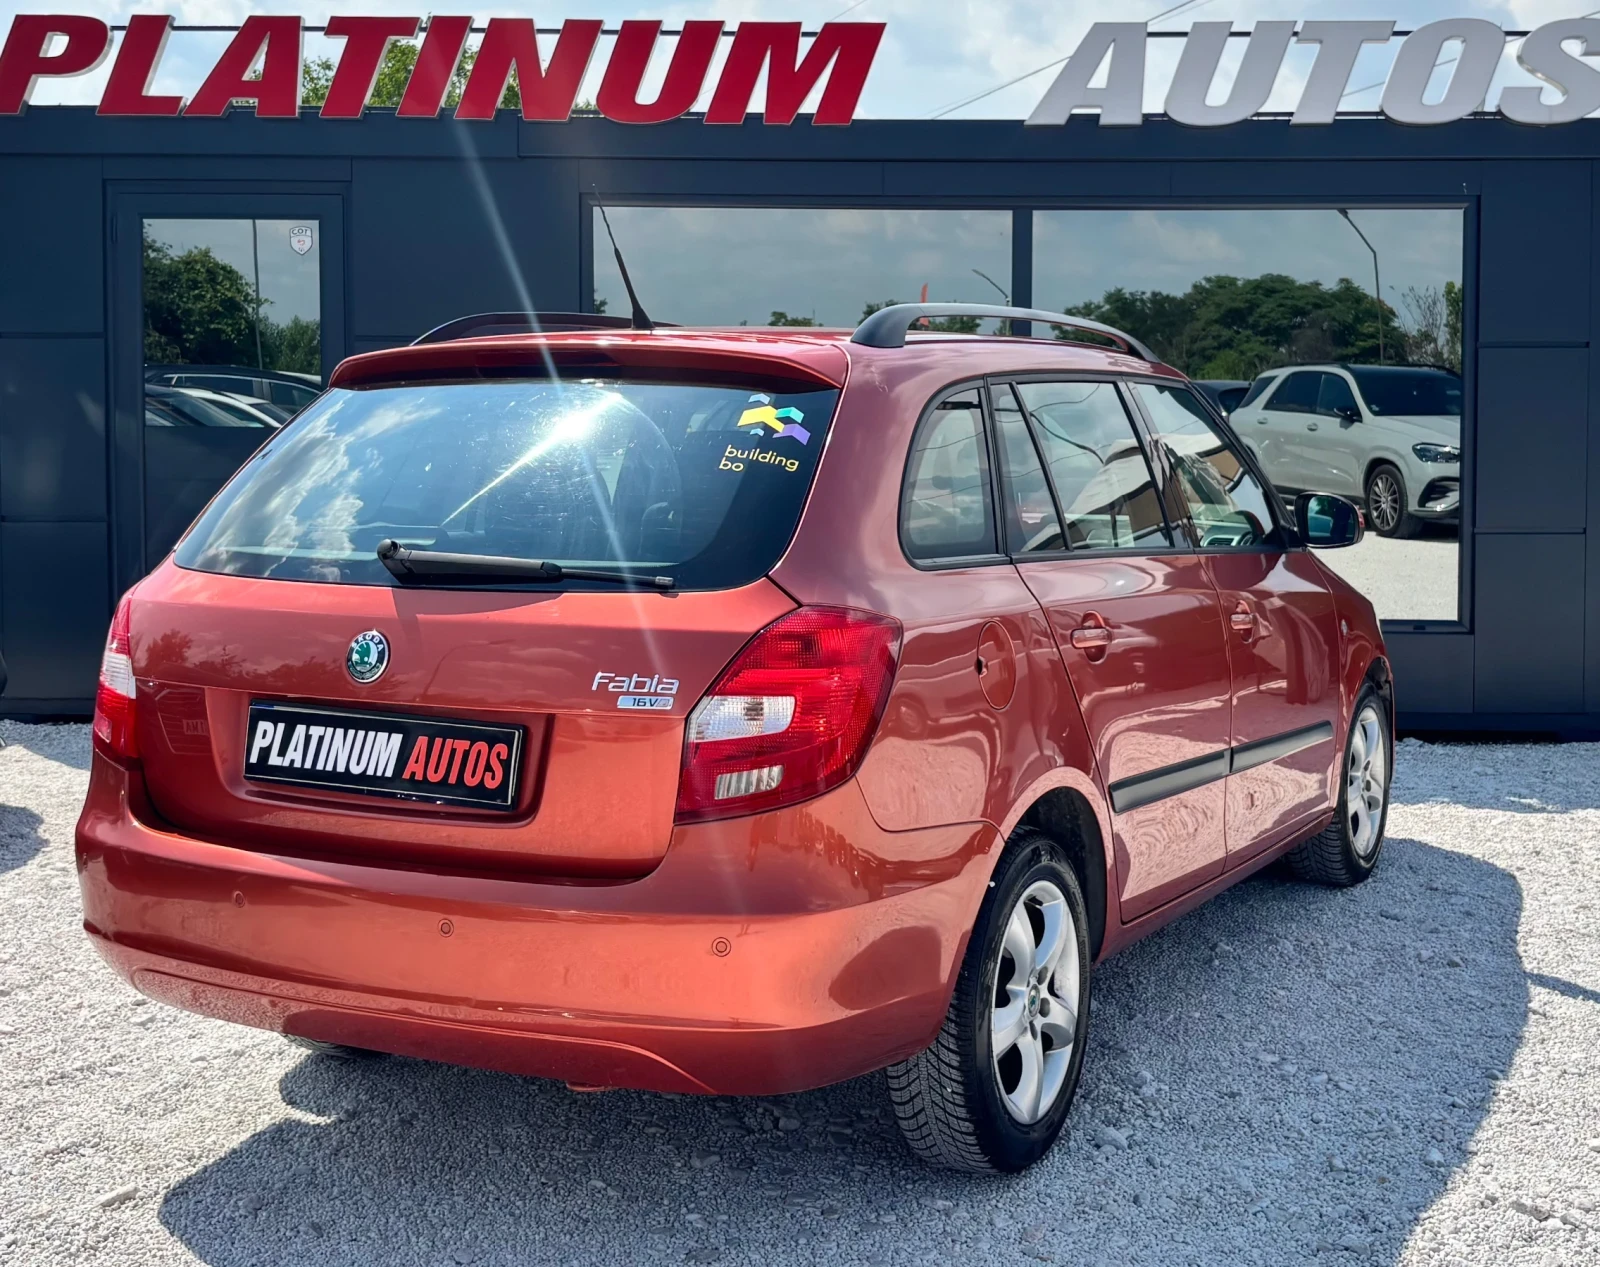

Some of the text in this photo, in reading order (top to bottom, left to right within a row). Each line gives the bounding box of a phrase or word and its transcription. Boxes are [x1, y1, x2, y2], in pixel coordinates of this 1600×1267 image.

[0, 14, 1600, 127] PLATINUM AUTOS
[718, 456, 744, 471] bo
[724, 444, 800, 472] building
[591, 671, 680, 695] Fabia
[249, 720, 508, 790] PLATINUM AUTOS
